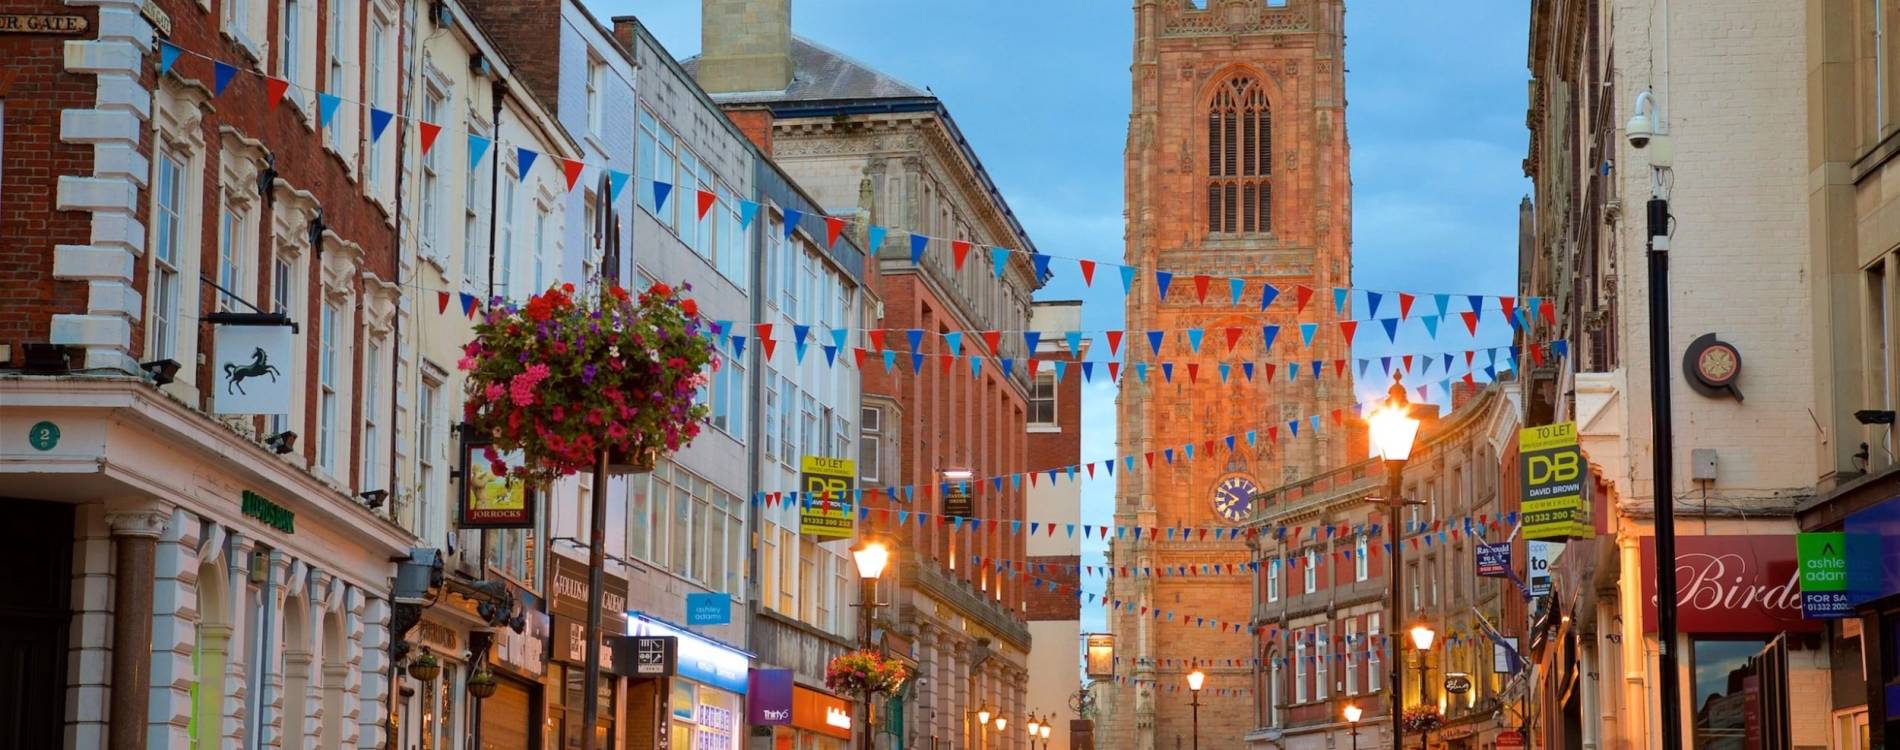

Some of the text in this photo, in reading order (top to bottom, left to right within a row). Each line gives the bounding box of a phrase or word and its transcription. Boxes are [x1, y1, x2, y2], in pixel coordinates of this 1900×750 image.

[39, 428, 50, 440] 2
[1536, 424, 1571, 440] TO LET
[814, 457, 843, 469] TO LET
[1529, 483, 1580, 497] DAVID BROWN
[472, 510, 521, 520] JORROCKS
[1524, 512, 1550, 524] 01332
[1552, 511, 1568, 521] 200
[1531, 556, 1547, 570] to
[1807, 557, 1845, 569] ashle
[1806, 570, 1846, 581] adam
[602, 591, 626, 612] CADEMY
[1807, 594, 1848, 603] FOR SA
[695, 606, 721, 614] ashley
[1807, 602, 1830, 611] 01332
